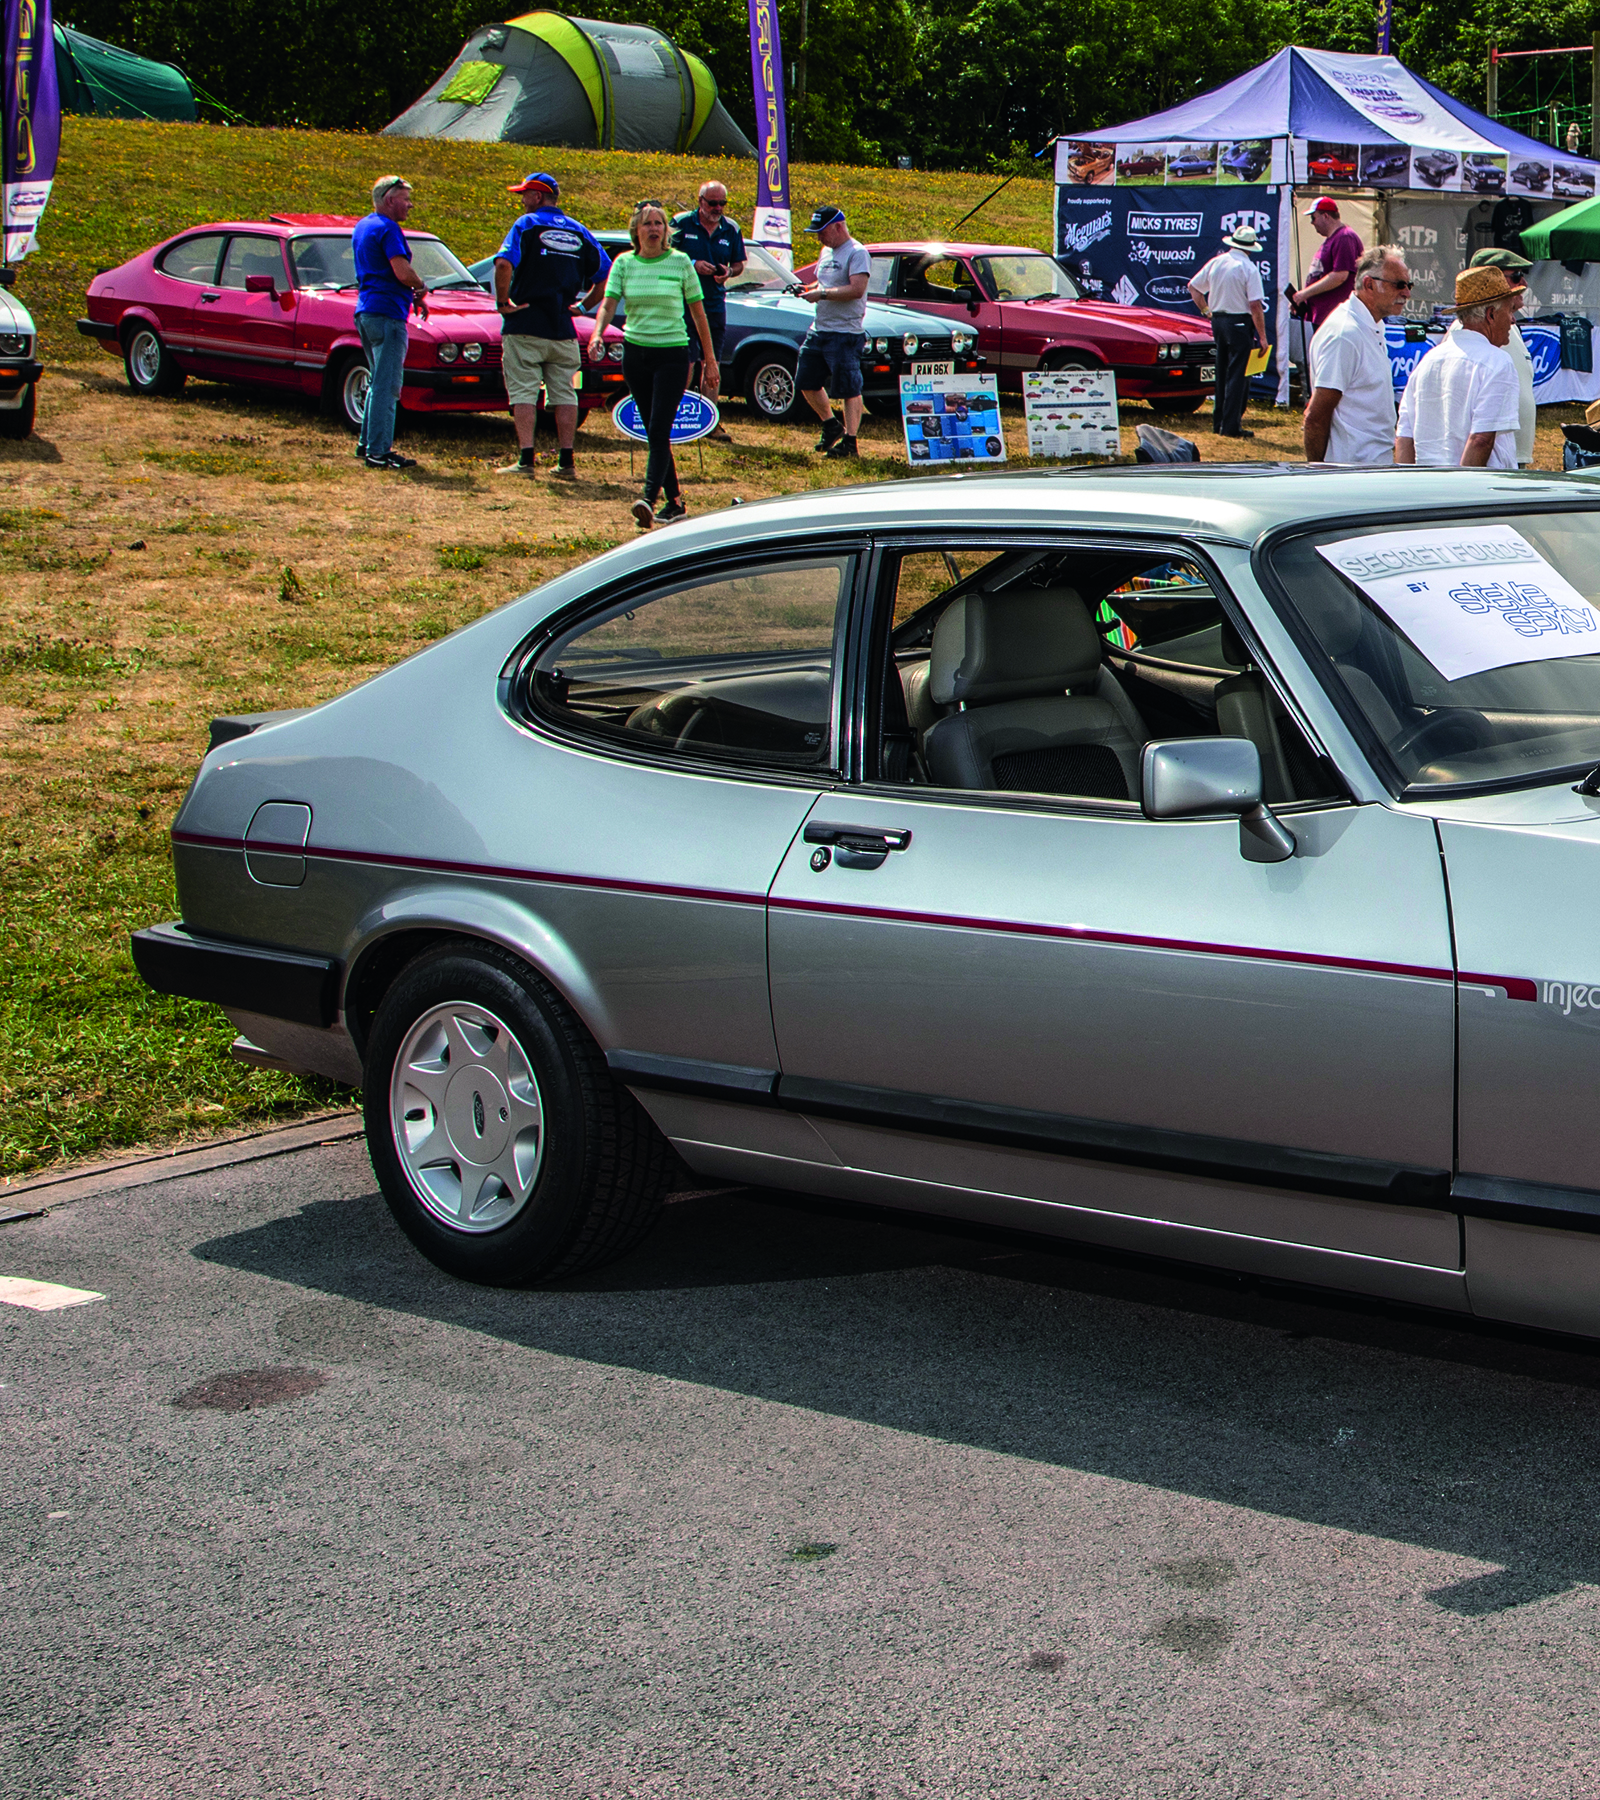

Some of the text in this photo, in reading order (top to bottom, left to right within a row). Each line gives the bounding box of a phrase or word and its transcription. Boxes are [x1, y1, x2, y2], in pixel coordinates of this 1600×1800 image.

[1131, 217, 1199, 231] NICKS TYRES
[1220, 210, 1272, 233] RTR
[902, 381, 933, 395] Capri
[1338, 538, 1536, 577] SECRET FORDS
[1406, 581, 1430, 593] BY
